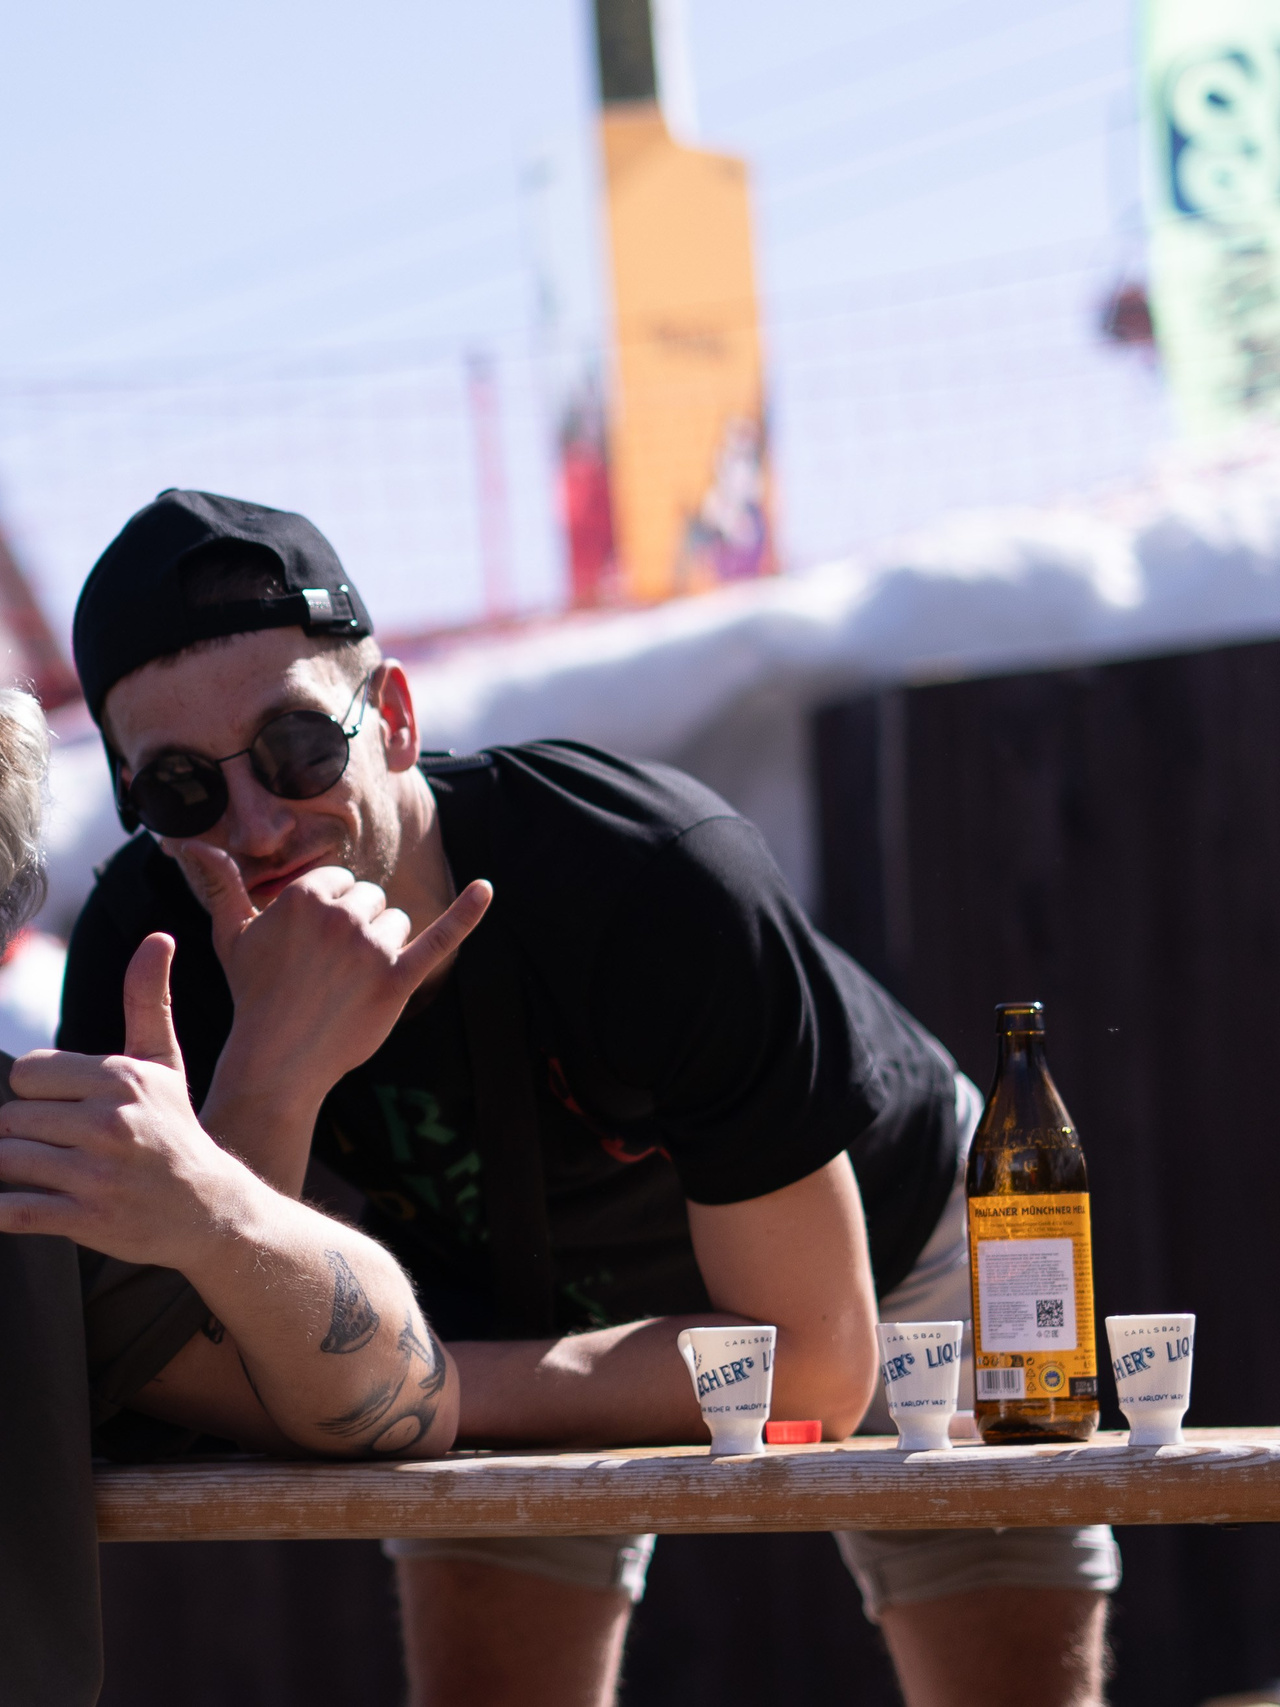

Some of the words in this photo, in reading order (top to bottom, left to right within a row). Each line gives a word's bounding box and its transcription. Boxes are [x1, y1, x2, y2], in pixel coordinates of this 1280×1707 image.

[974, 1207, 1018, 1218] PAULANER
[1021, 1205, 1071, 1216] MÜNCHNER
[1124, 1325, 1181, 1337] CARLSBAD
[886, 1332, 942, 1343] CARLSBAD
[1138, 1394, 1169, 1402] KARLOVY
[735, 1403, 763, 1411] KARLOVY
[900, 1399, 930, 1407] KARLOVY
